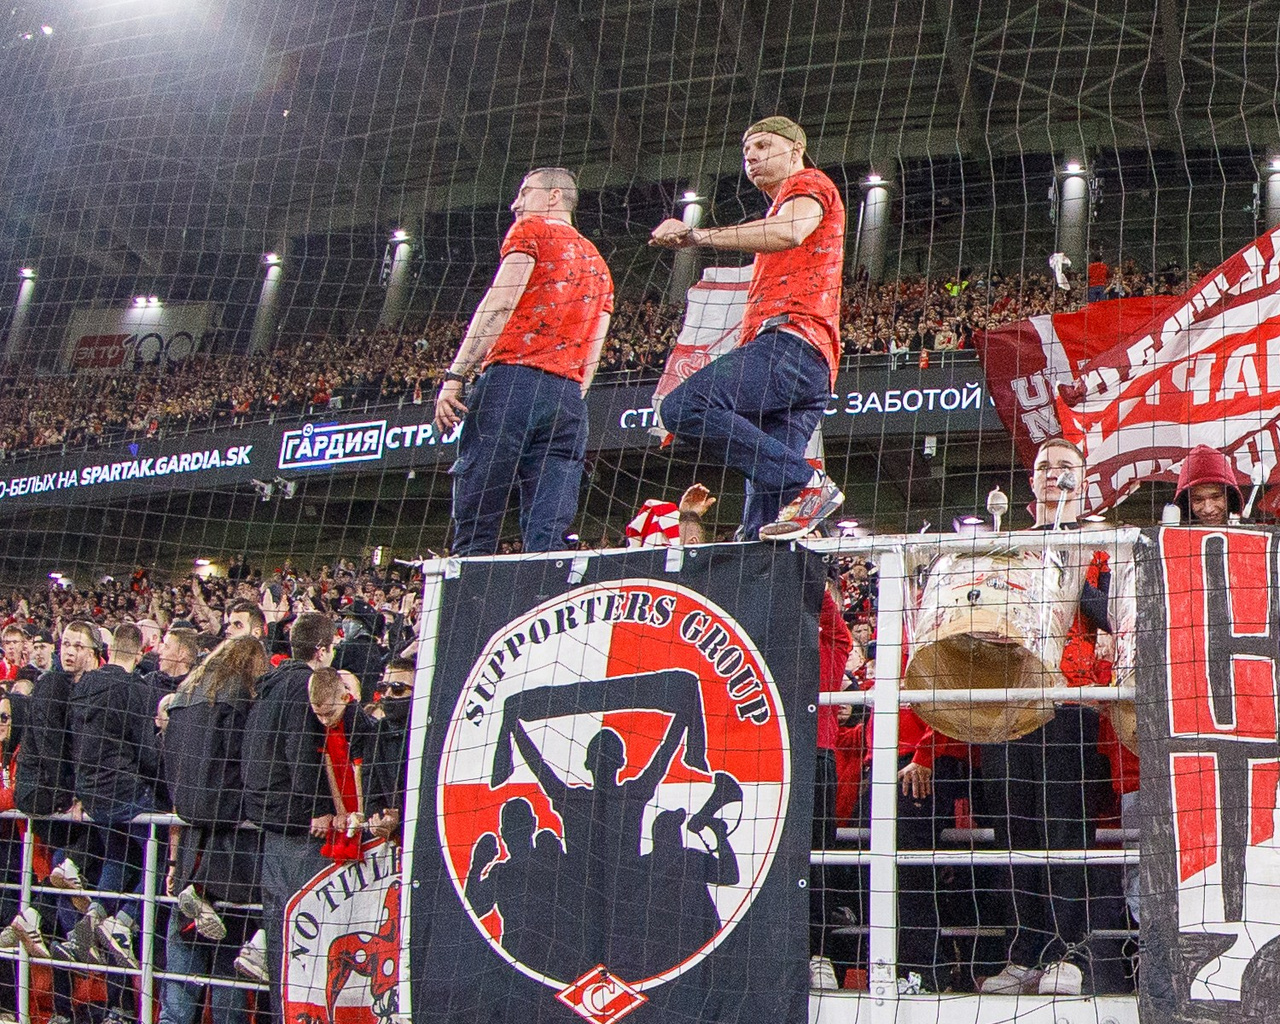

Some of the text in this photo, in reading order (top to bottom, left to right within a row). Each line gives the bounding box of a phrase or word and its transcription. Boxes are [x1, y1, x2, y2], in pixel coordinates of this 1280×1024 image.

[845, 382, 981, 414] ЗАБОТОЙ
[285, 428, 380, 460] ГАРДИЯ
[57, 470, 79, 489] НА
[80, 445, 253, 486] SPARTAK.GARDIA.SK
[465, 590, 772, 728] SUPPORTERS GROUP
